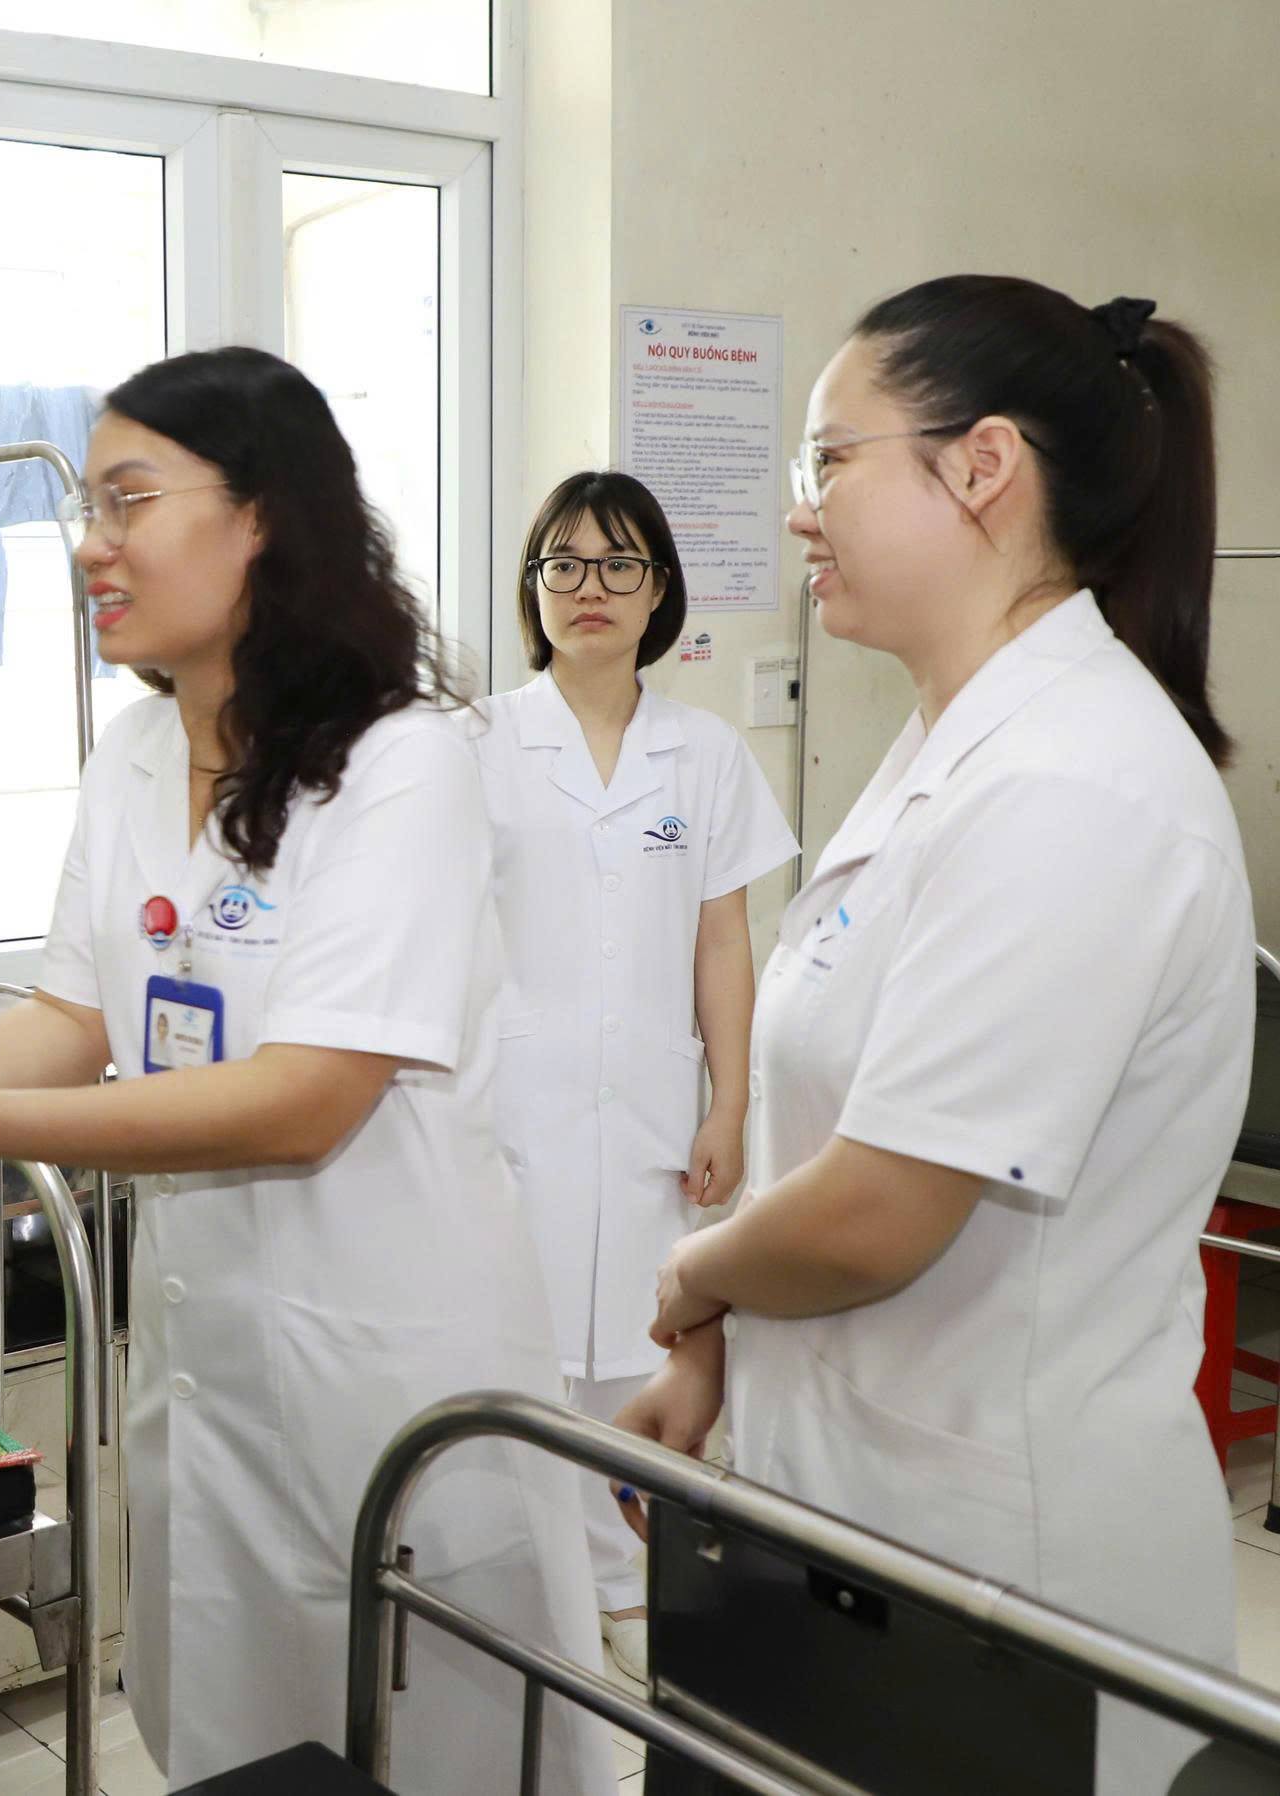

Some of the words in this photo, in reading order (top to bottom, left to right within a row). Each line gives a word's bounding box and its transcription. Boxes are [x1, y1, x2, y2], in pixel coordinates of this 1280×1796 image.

[648, 342, 667, 360] NỘI
[669, 345, 691, 359] QUY
[730, 348, 758, 364] BỆNH
